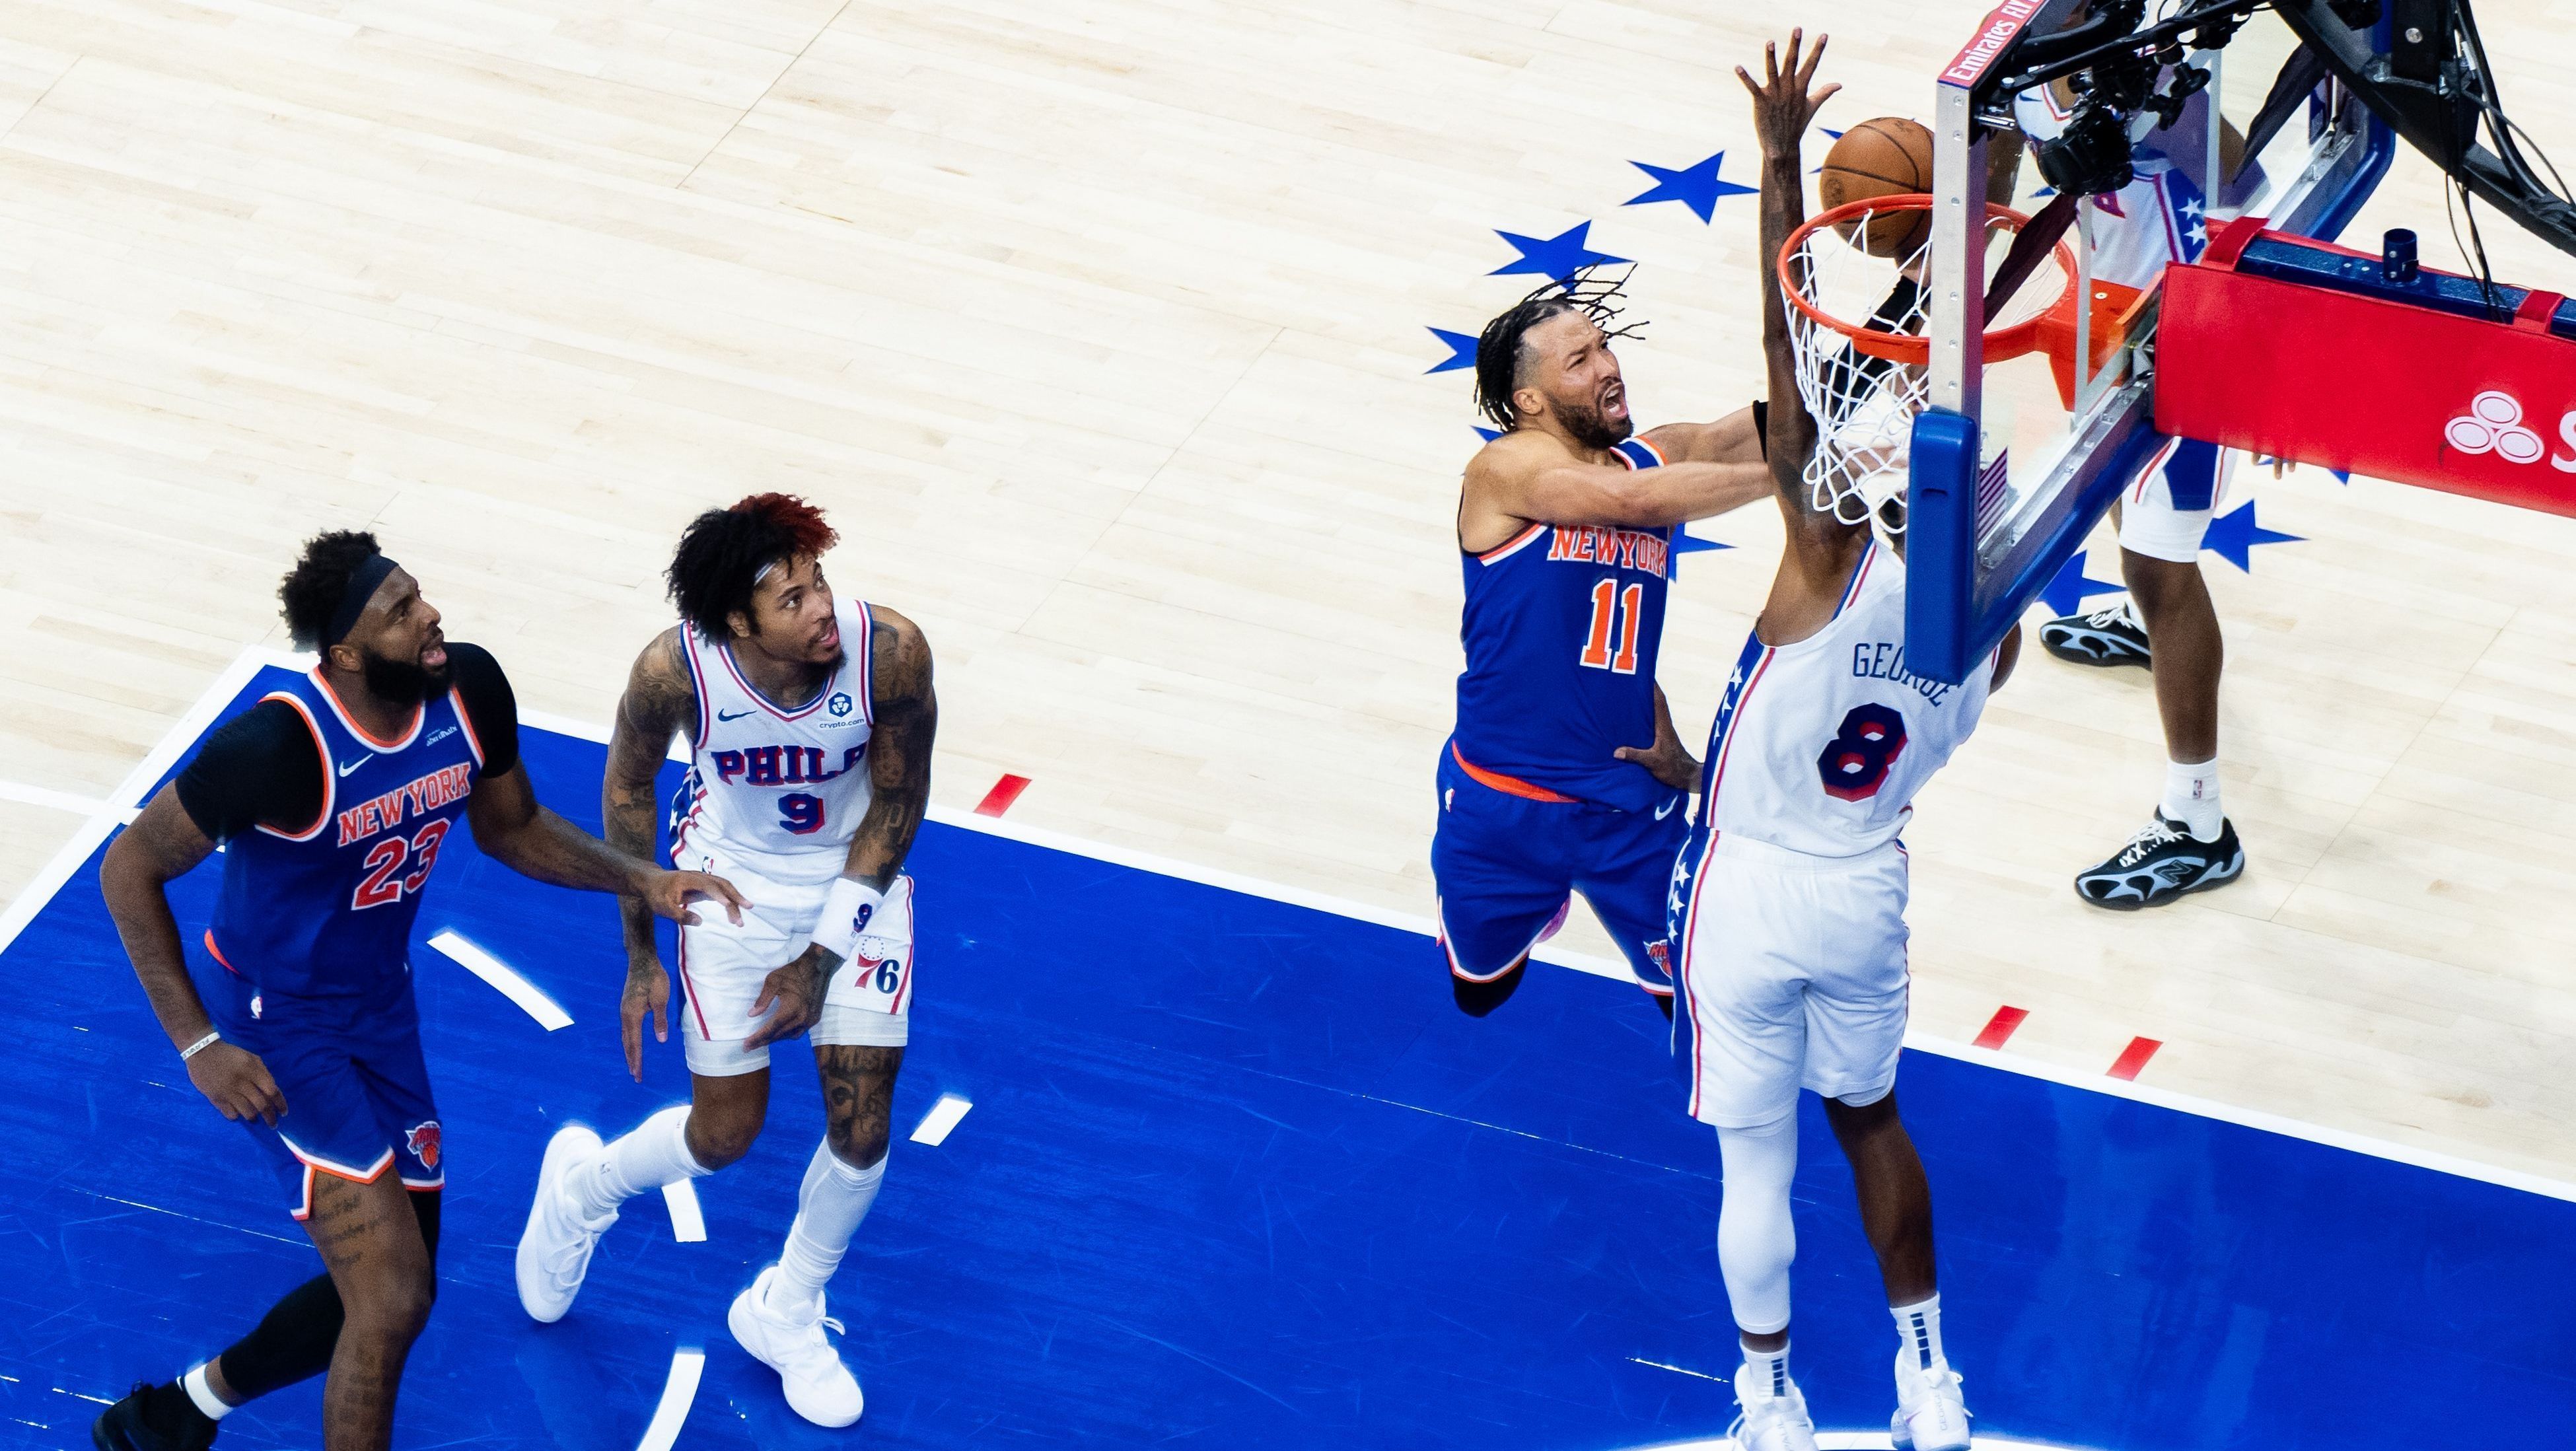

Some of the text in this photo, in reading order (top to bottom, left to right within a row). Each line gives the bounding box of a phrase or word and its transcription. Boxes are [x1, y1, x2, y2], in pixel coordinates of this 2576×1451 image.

[1946, 20, 2017, 81] Emirates
[1547, 525, 1670, 580] NEW YORK
[1579, 578, 1643, 675] 11
[819, 719, 865, 728] crypto.com
[1818, 702, 1908, 802] 8
[338, 761, 471, 848] NEW YORK
[777, 793, 825, 835] 9
[351, 817, 452, 911] 23
[853, 903, 873, 933] 9
[854, 947, 900, 994] 76
